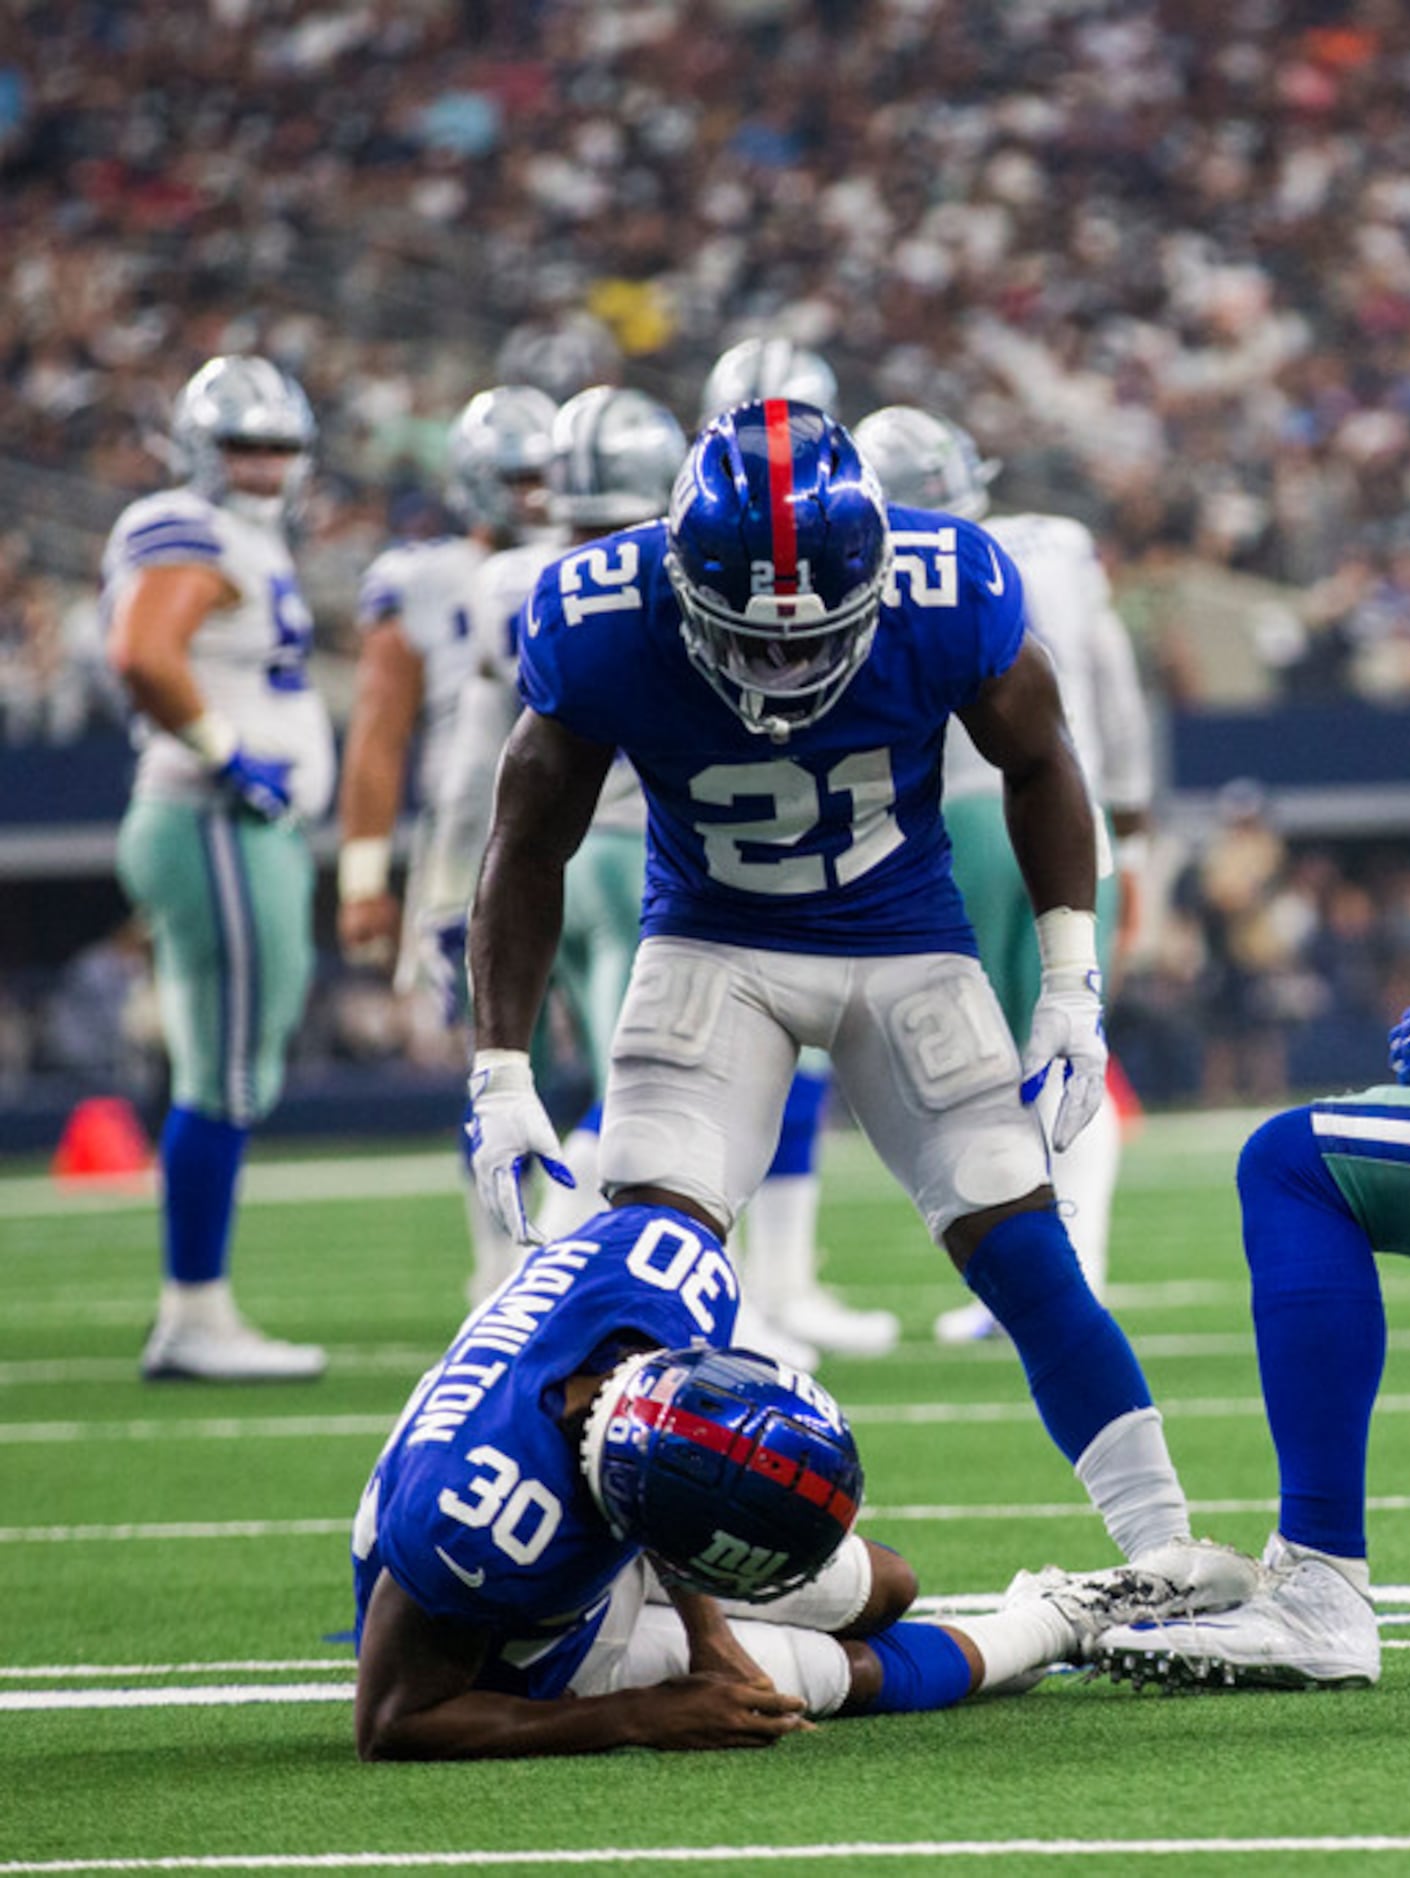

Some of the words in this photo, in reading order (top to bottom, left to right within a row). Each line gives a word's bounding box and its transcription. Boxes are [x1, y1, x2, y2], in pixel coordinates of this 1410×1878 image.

[559, 541, 643, 627] 21
[750, 559, 814, 595] 21
[882, 527, 958, 608] 21
[688, 747, 907, 895] 21
[902, 974, 1002, 1081] 21
[625, 1217, 738, 1334] 30
[406, 1240, 601, 1446] HAMILTON
[437, 1444, 563, 1566] 30
